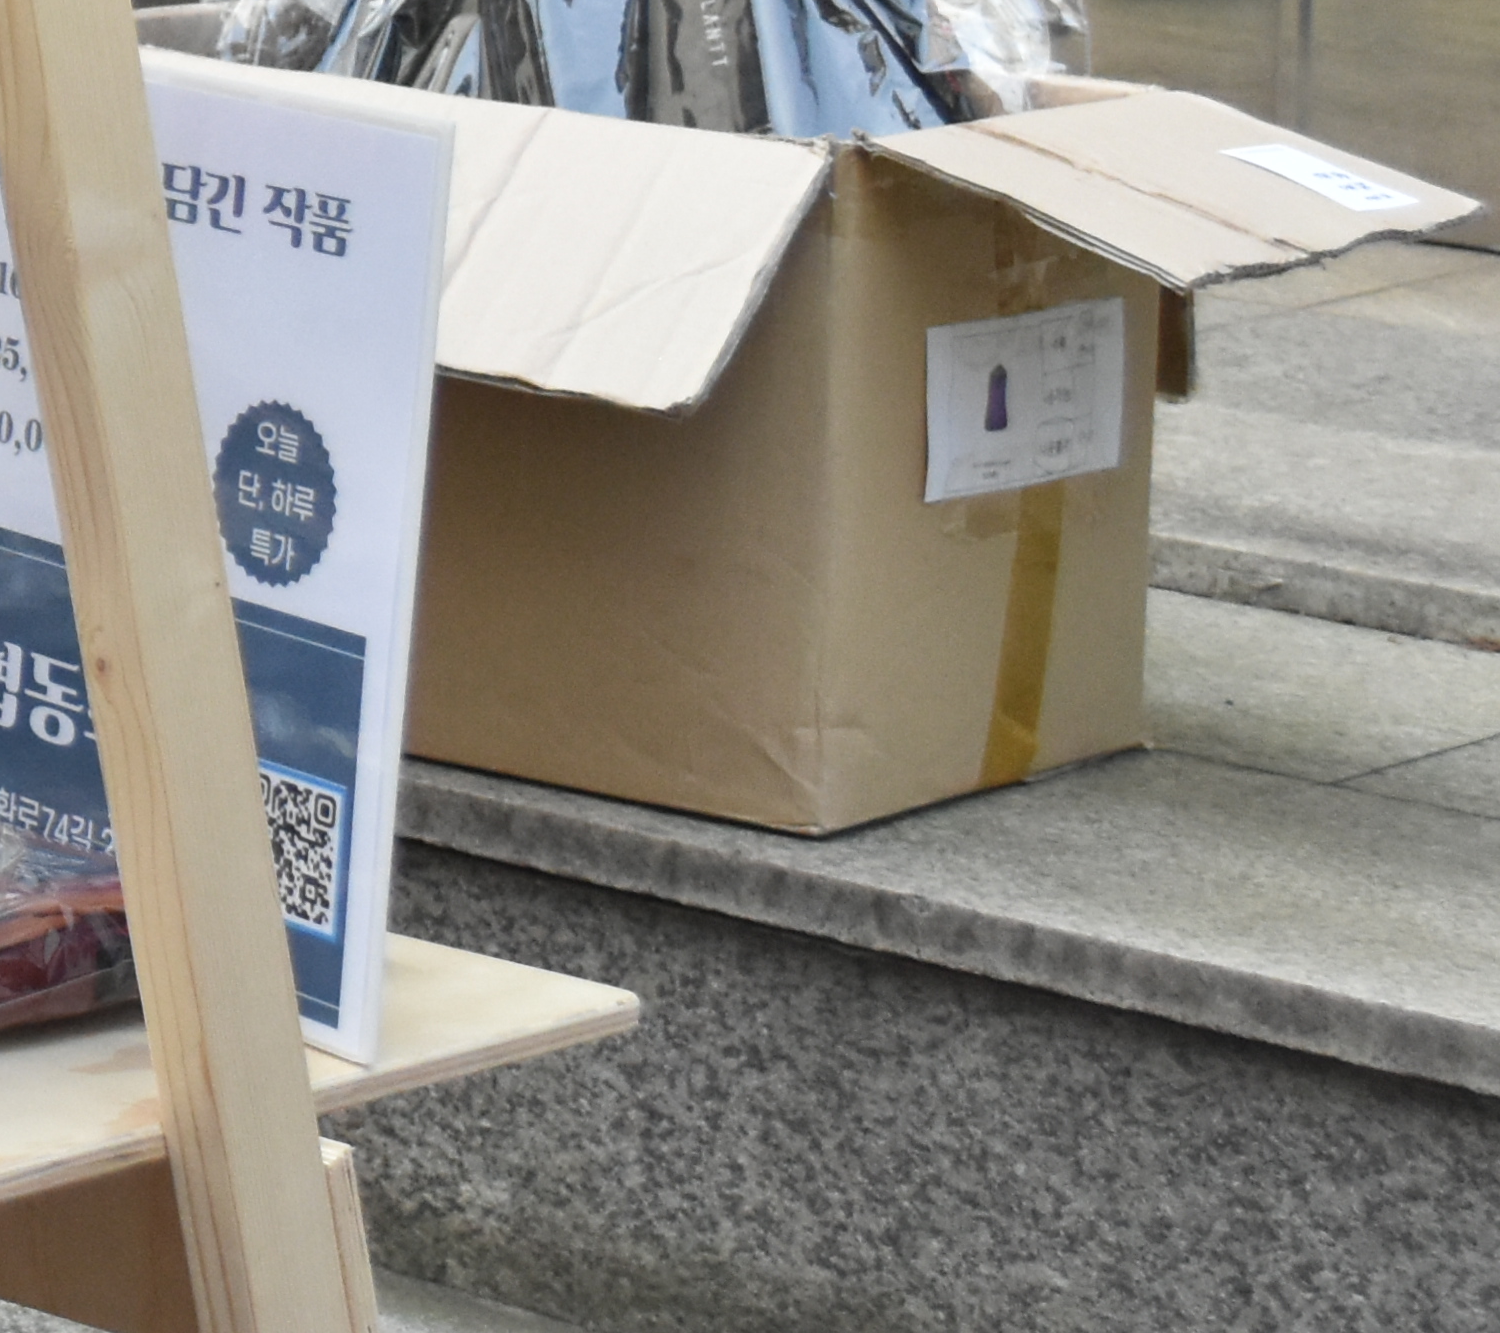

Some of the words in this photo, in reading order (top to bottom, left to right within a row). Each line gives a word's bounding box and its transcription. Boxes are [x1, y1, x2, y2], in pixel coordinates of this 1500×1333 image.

[162, 162, 246, 234] 담긴
[262, 184, 354, 258] 작품
[255, 421, 300, 464] 오늘
[271, 478, 316, 522] 하루
[250, 527, 296, 572] 특가
